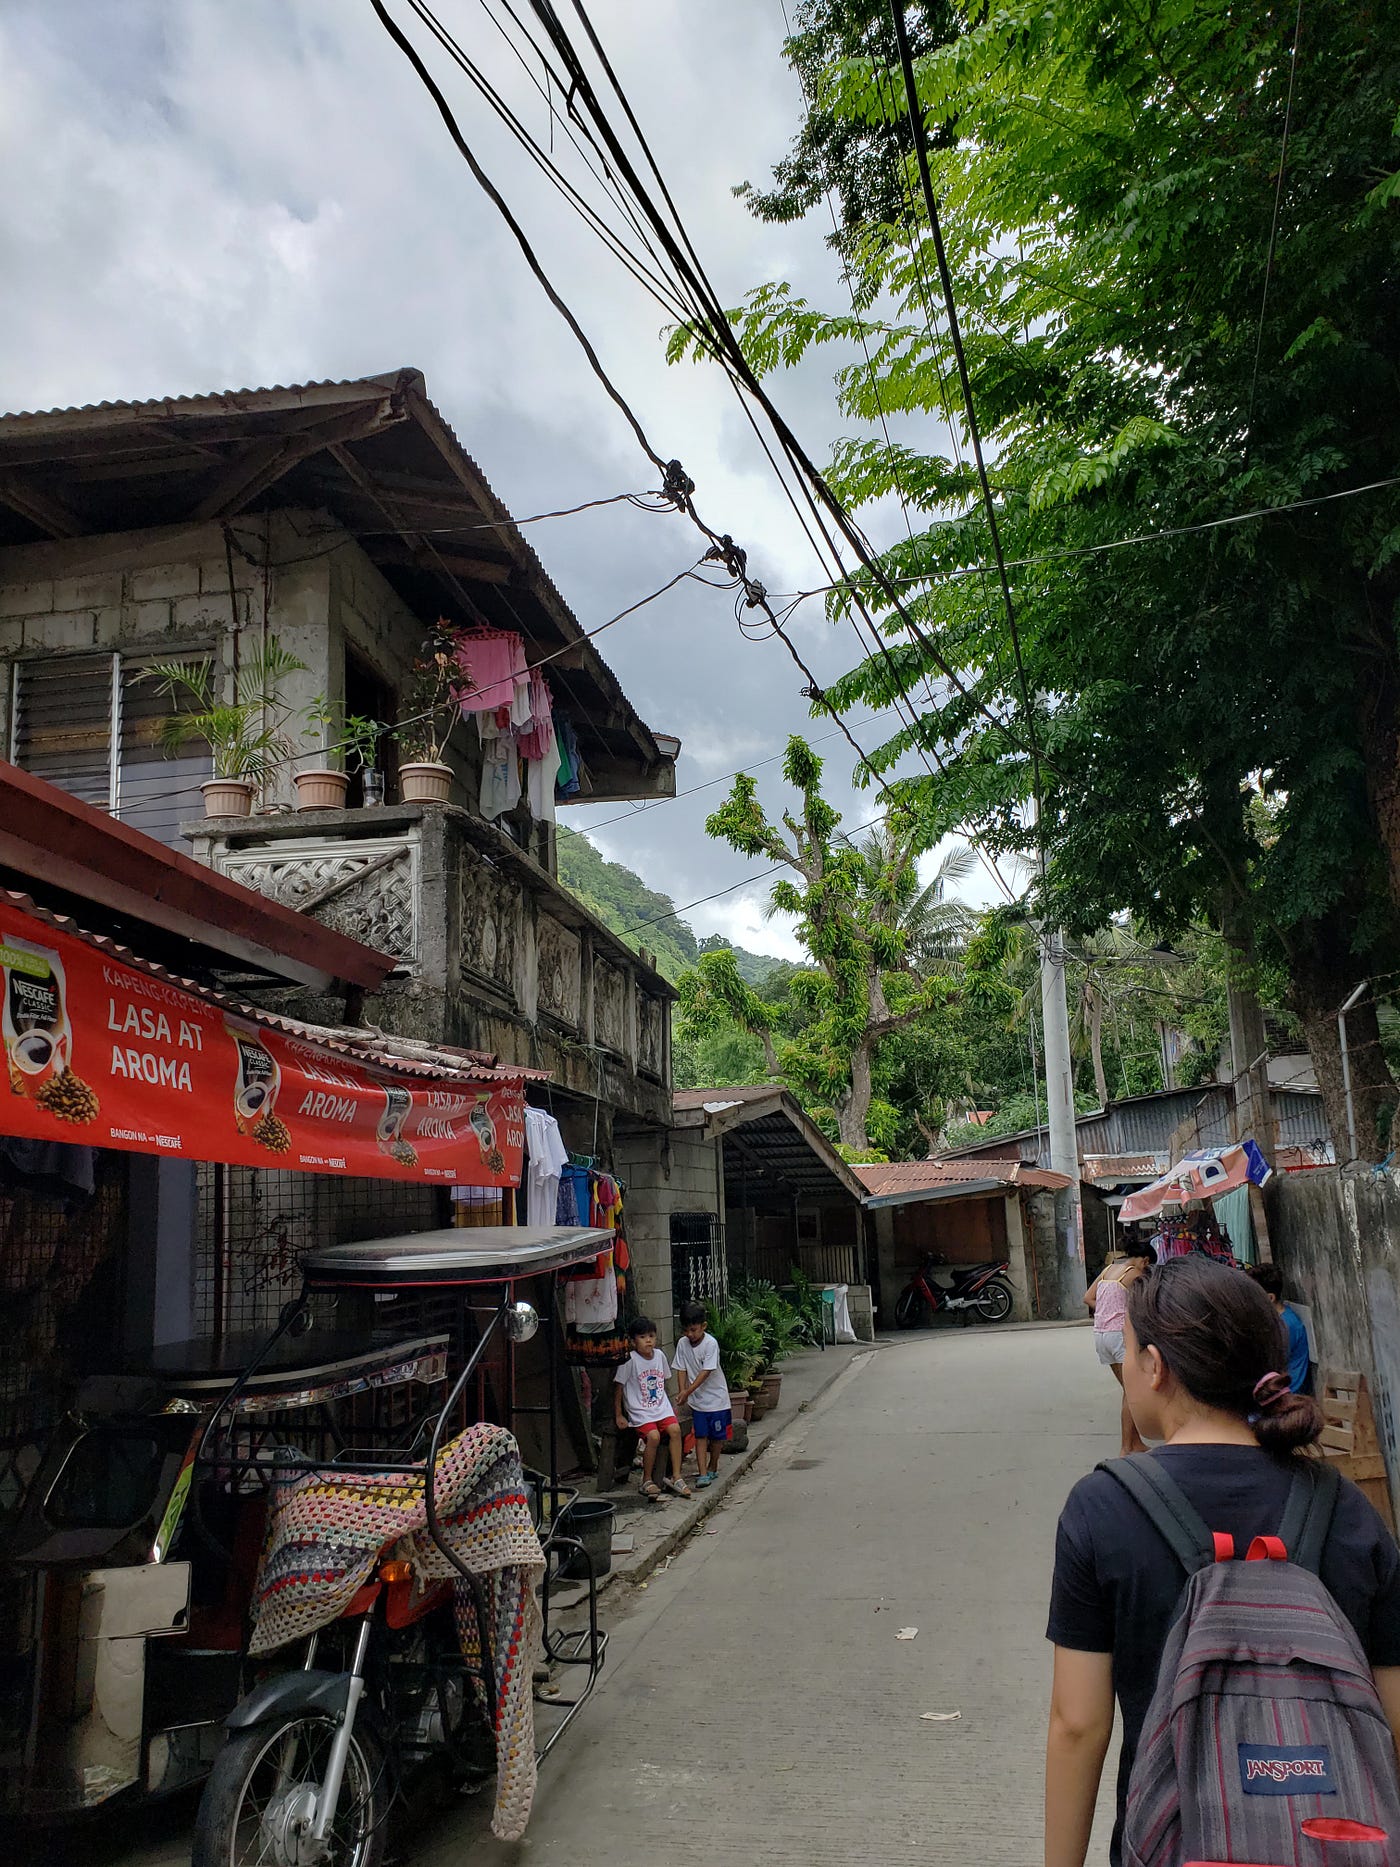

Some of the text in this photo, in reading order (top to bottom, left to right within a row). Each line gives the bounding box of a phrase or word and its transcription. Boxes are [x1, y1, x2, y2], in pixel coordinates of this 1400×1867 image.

[23, 997, 53, 1012] CLASSIC
[108, 998, 171, 1044] LASA
[178, 1020, 203, 1051] AT
[110, 1045, 193, 1093] AROMA
[295, 1058, 344, 1087] LASA
[298, 1090, 357, 1123] AROMA
[426, 1090, 452, 1112] LASA
[451, 1094, 467, 1113] AT
[110, 1127, 137, 1141] BANGON
[137, 1131, 148, 1143] NA
[416, 1116, 457, 1140] AROMA
[1246, 1759, 1324, 1783] JANSPORT
